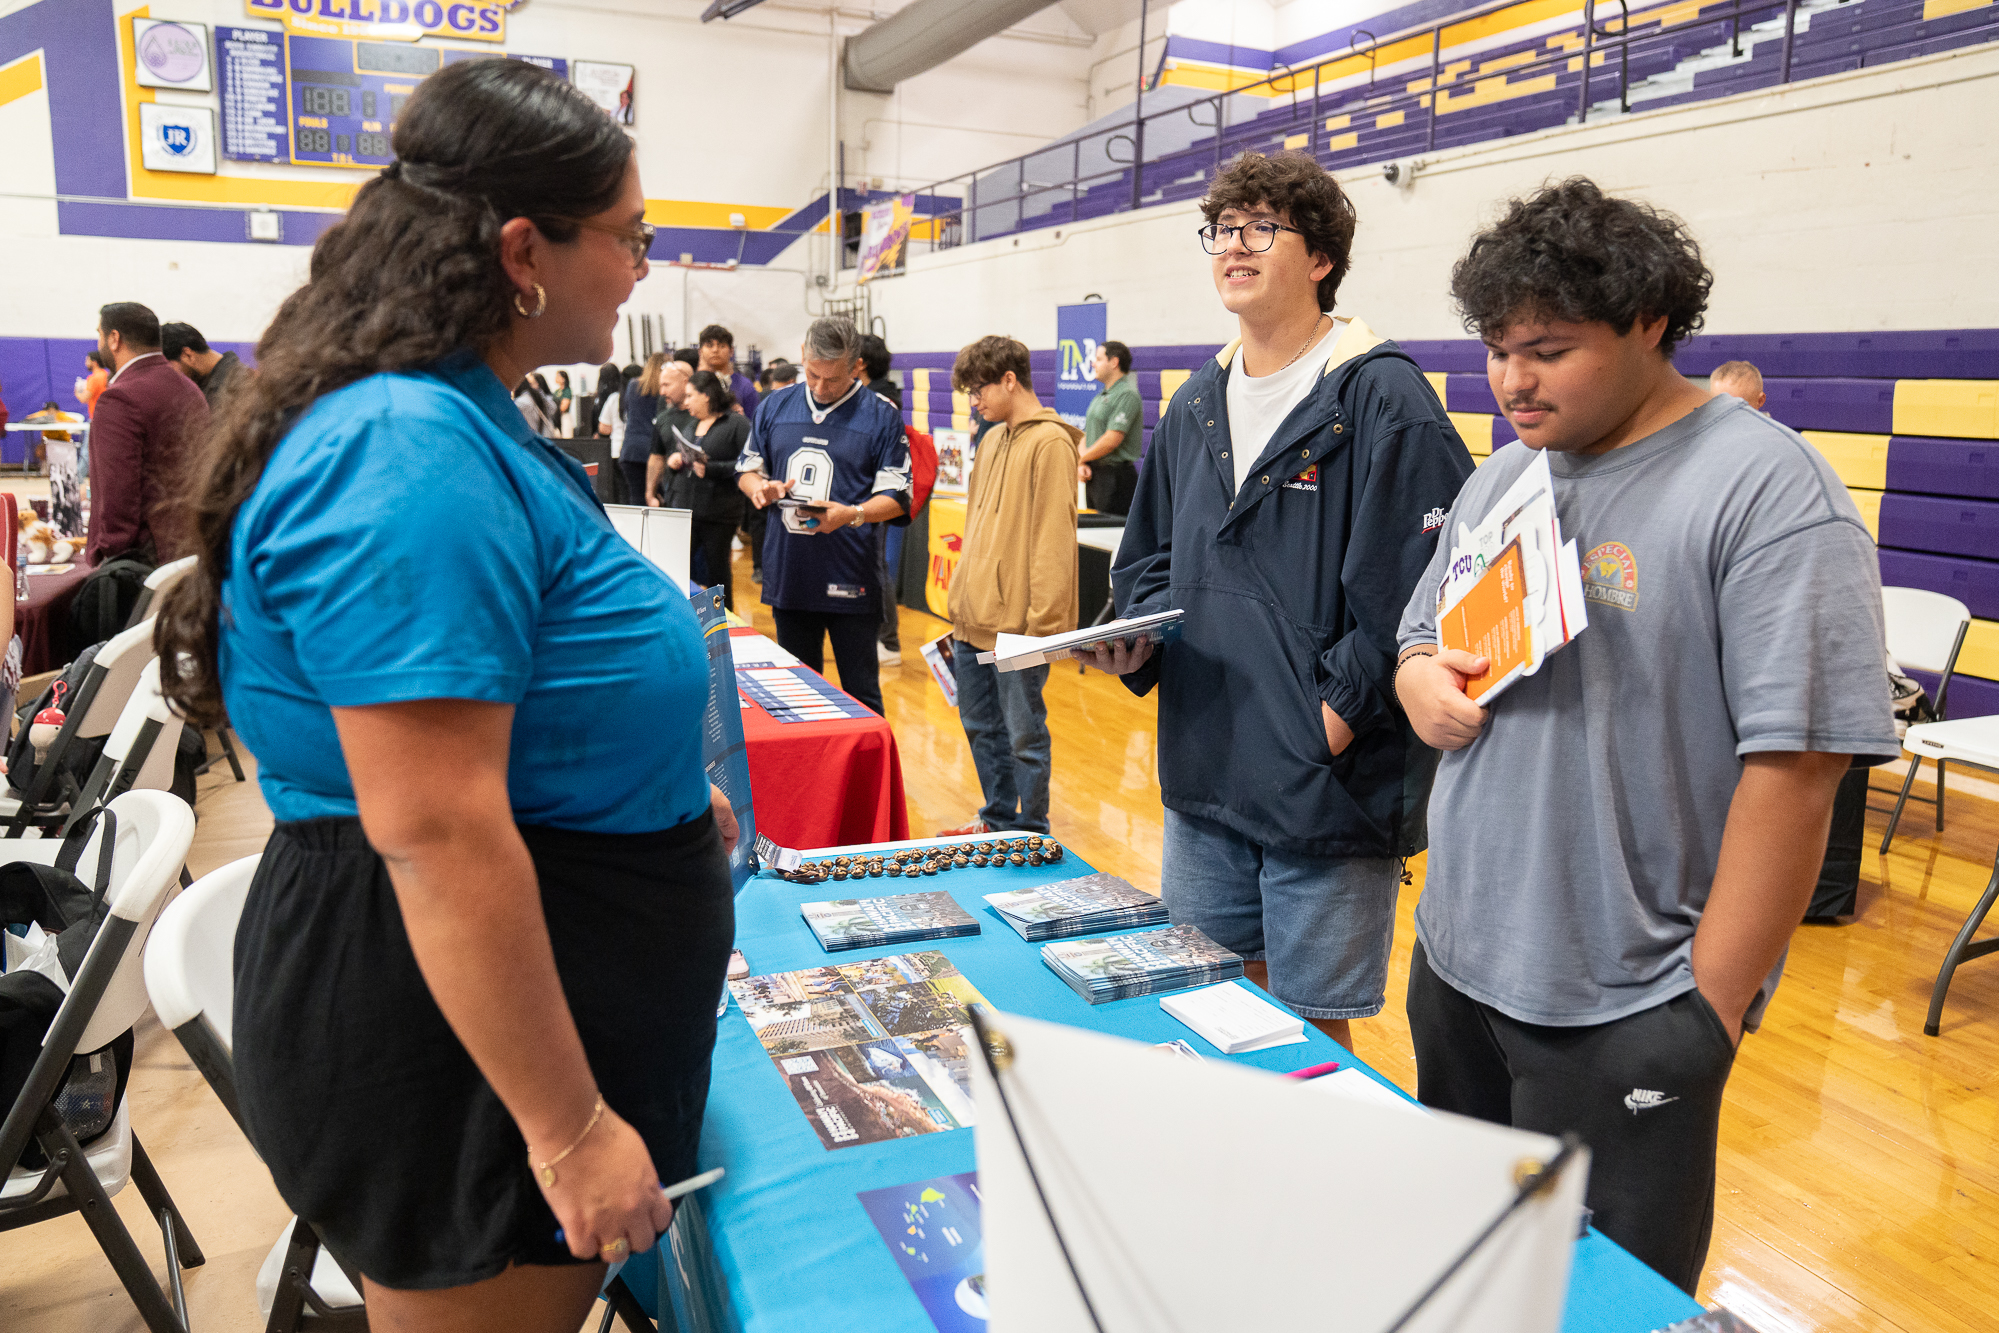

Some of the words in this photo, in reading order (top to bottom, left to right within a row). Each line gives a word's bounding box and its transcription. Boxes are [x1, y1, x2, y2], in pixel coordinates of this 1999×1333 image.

[1423, 513, 1450, 529] Pepp
[1431, 507, 1445, 518] Dr
[1452, 554, 1471, 582] TCU
[1584, 545, 1633, 577] ESPECIAL
[1584, 584, 1634, 607] HOMBRE
[1632, 1088, 1665, 1103] NIKE
